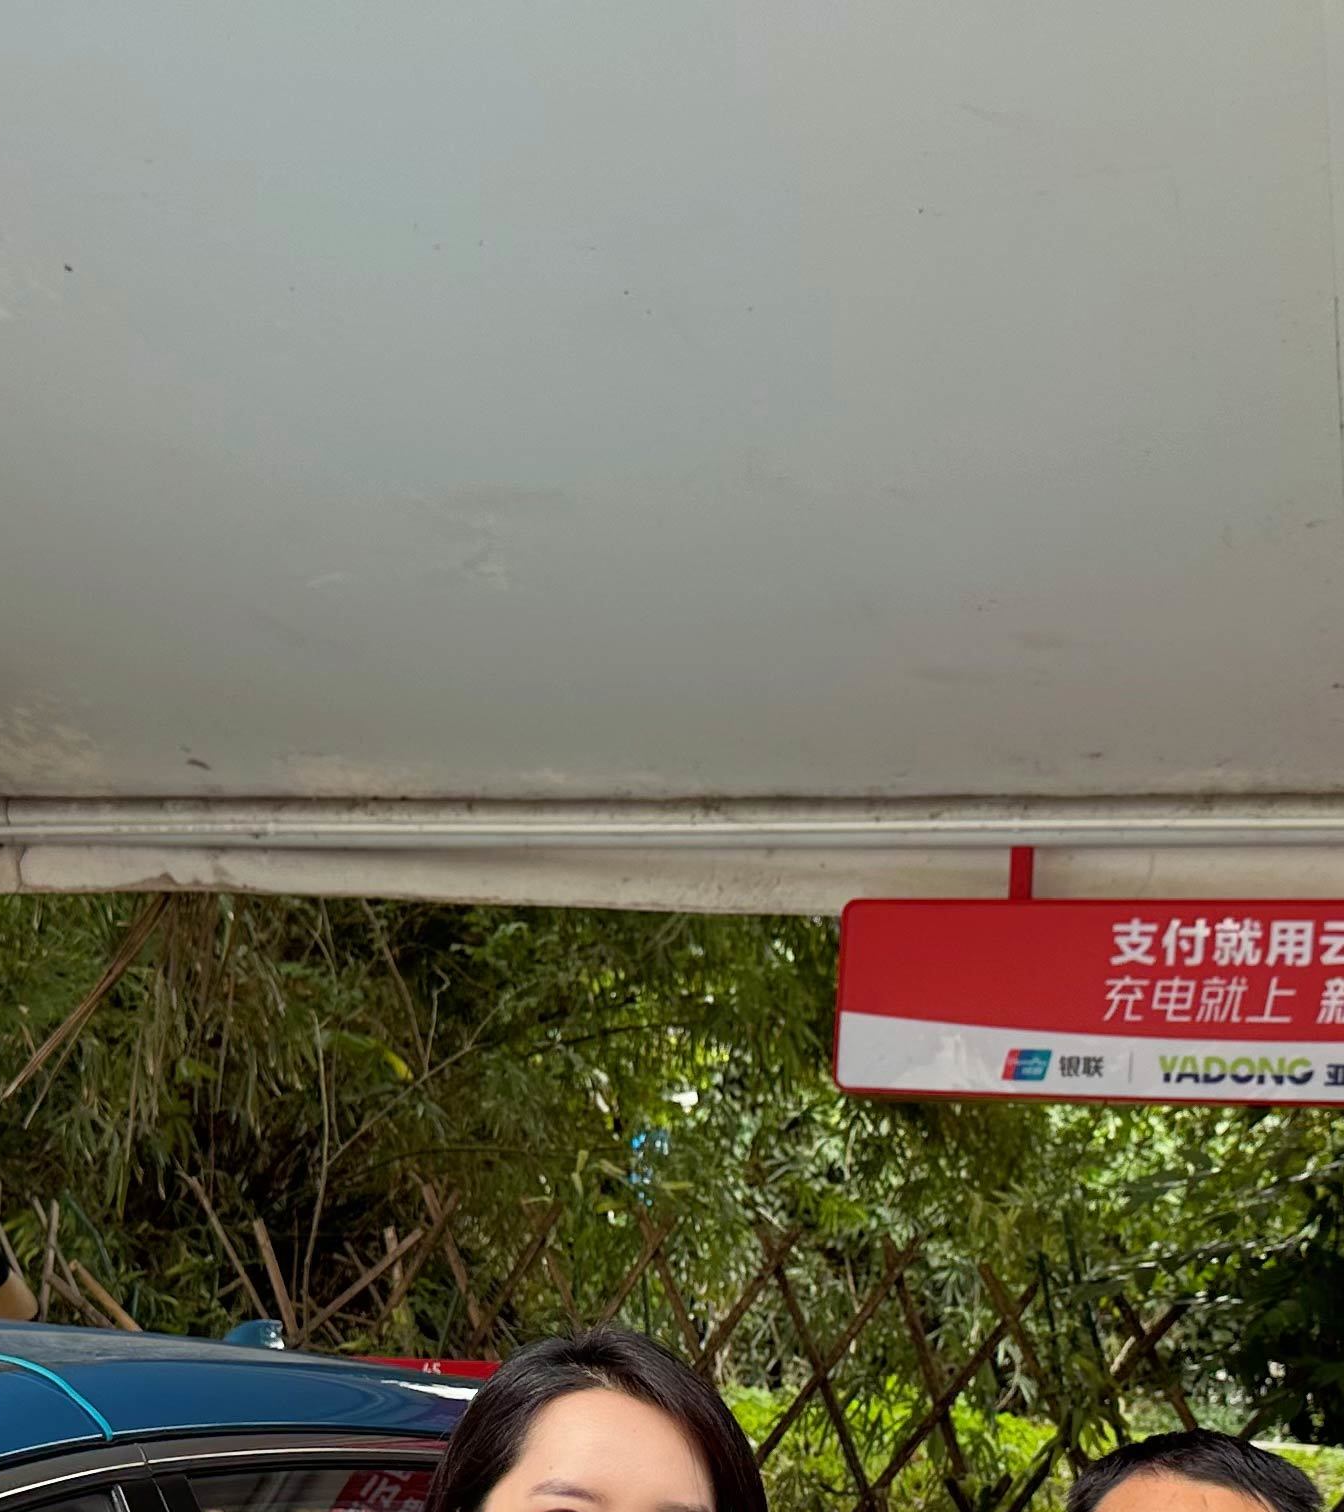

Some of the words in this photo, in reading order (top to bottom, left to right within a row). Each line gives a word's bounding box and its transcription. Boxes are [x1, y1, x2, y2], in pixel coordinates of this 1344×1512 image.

[1103, 975, 1296, 1024] 充电就上
[1058, 1056, 1104, 1078] 银联
[1159, 1055, 1314, 1085] YADONG
